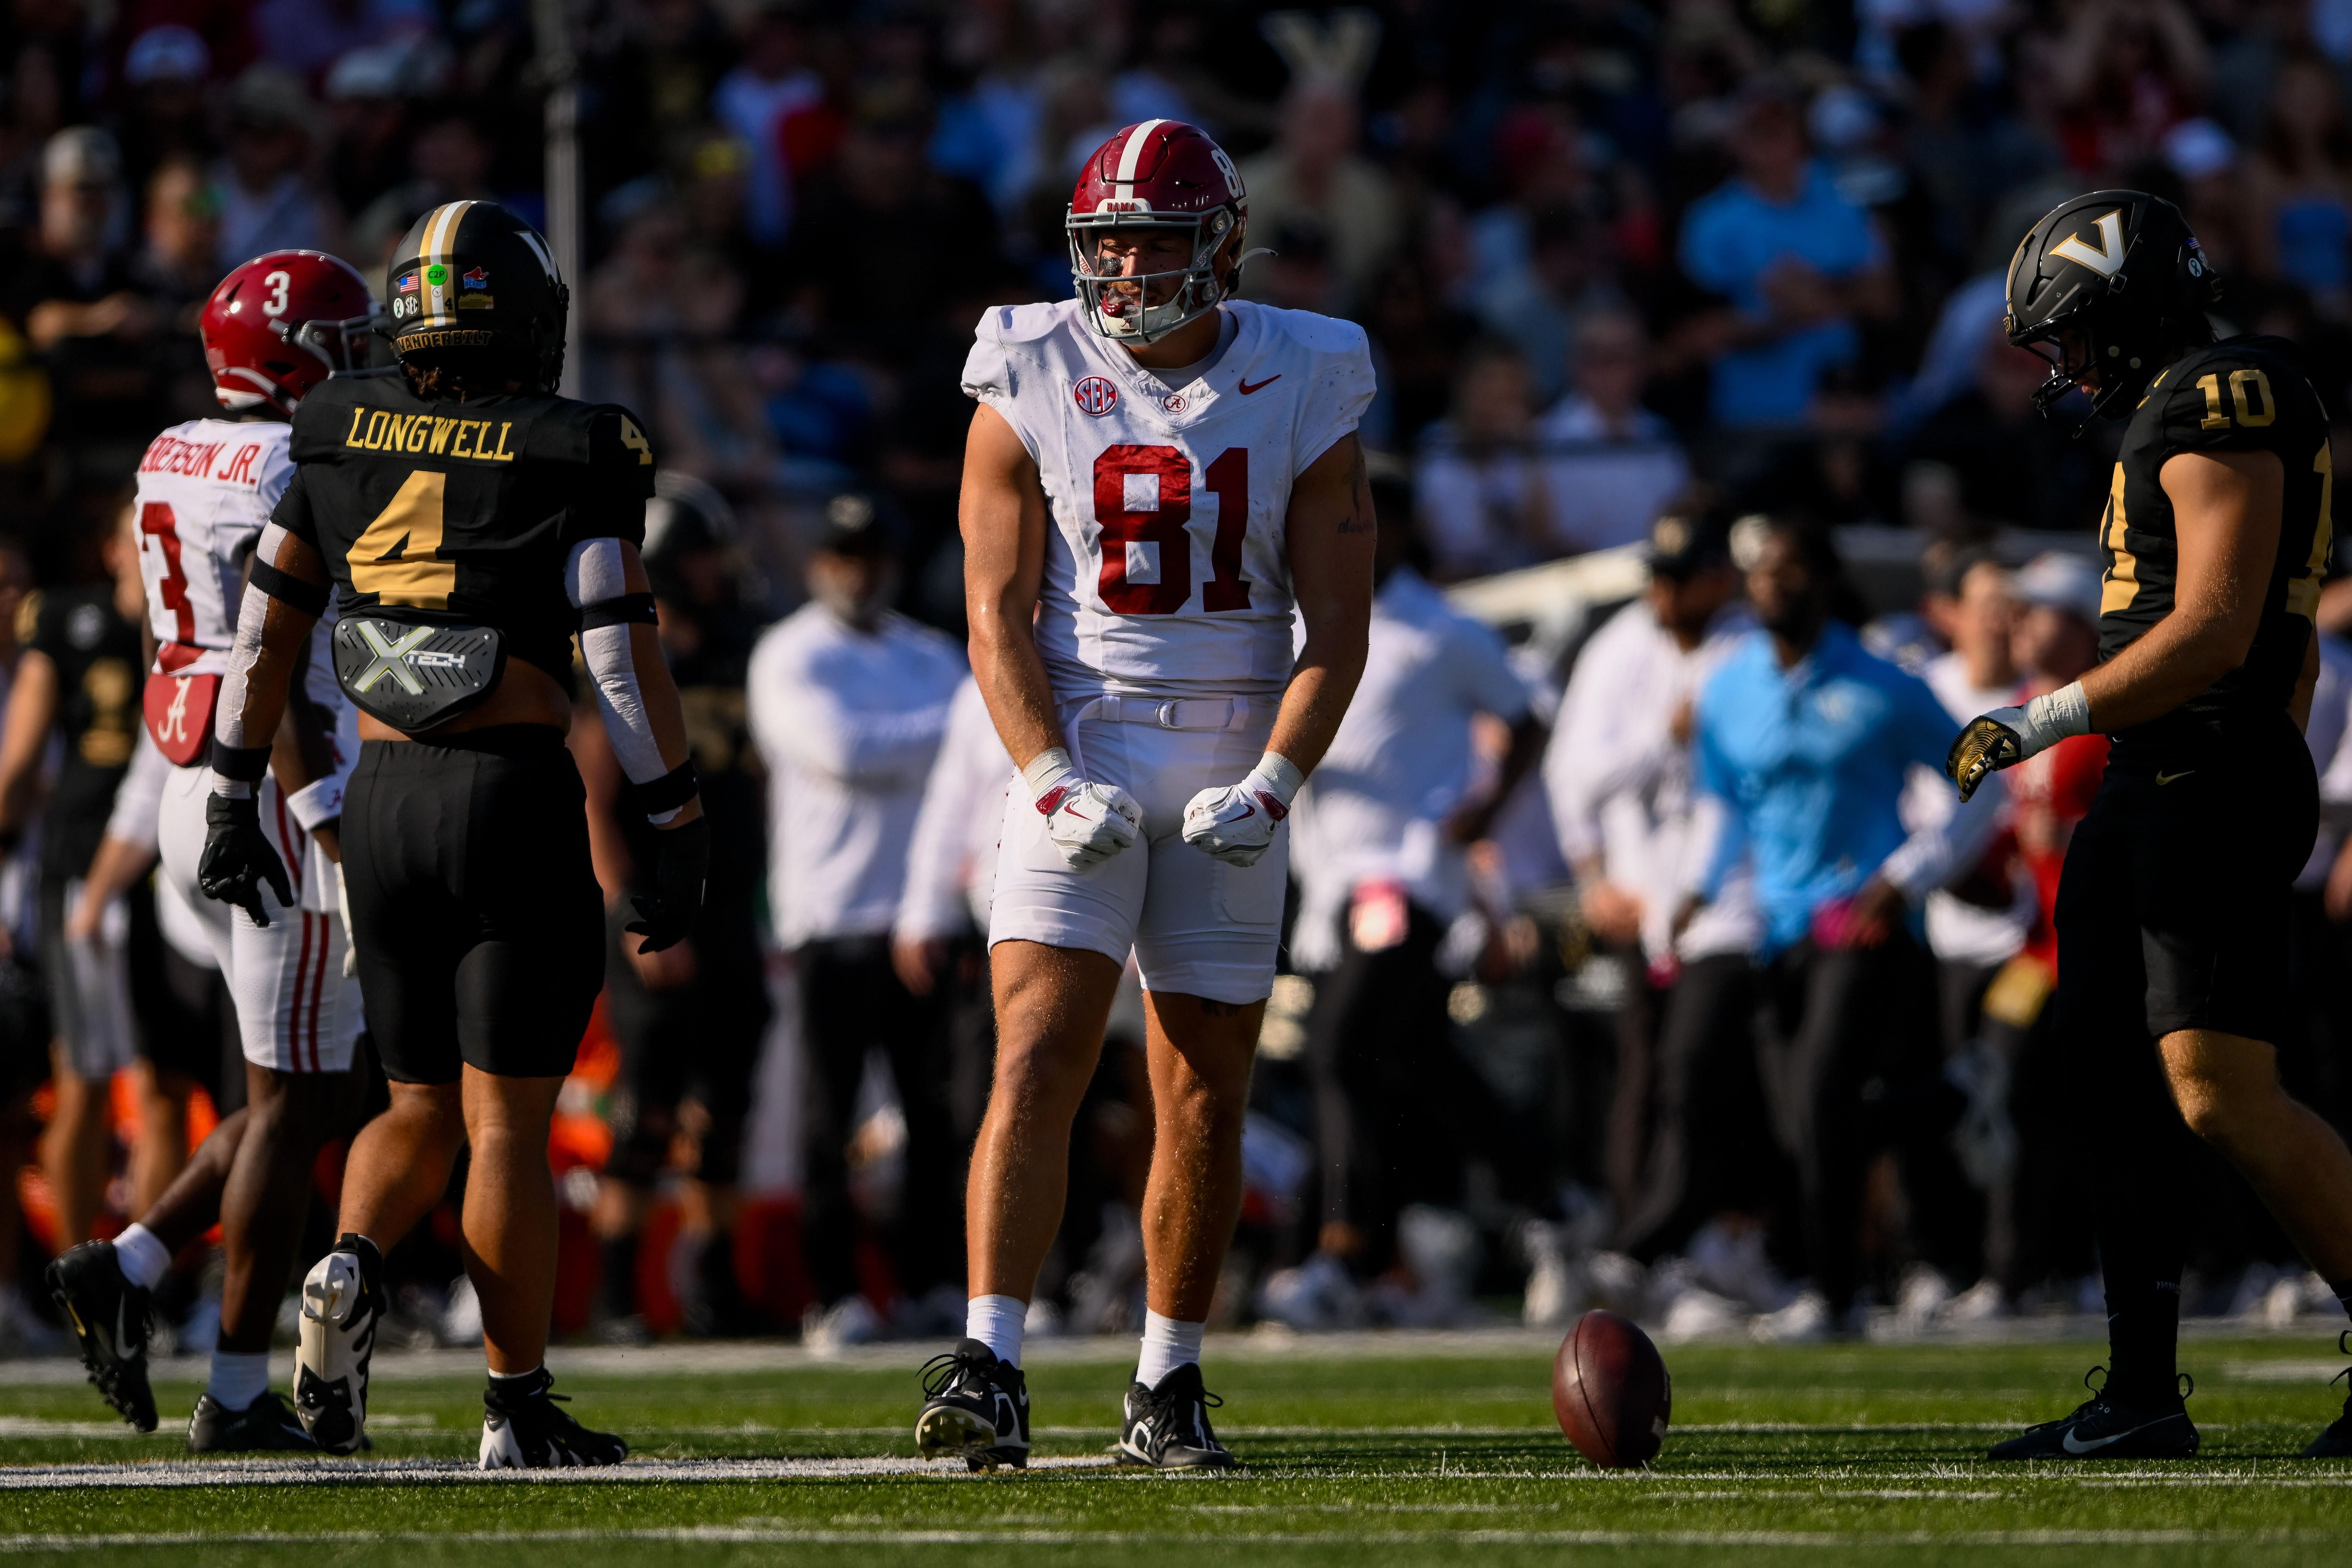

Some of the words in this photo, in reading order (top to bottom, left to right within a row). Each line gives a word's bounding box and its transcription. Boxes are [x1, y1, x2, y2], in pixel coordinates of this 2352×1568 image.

[1107, 202, 1136, 212] BAMA
[2048, 209, 2126, 279] V
[428, 270, 445, 279] C2P
[1079, 257, 1091, 274] TIDE
[263, 271, 289, 316] 3
[405, 296, 419, 315] SEC
[444, 297, 453, 311] 4
[396, 330, 493, 352] VANDERBILT
[1077, 377, 1114, 413] SEC
[1166, 397, 1181, 409] A
[2196, 370, 2276, 430] 10
[346, 407, 515, 461] LONGWELL
[621, 413, 653, 465] 4
[217, 444, 261, 486] JR.
[346, 470, 456, 610] 4
[1093, 444, 1253, 615] 81
[158, 675, 192, 742] A
